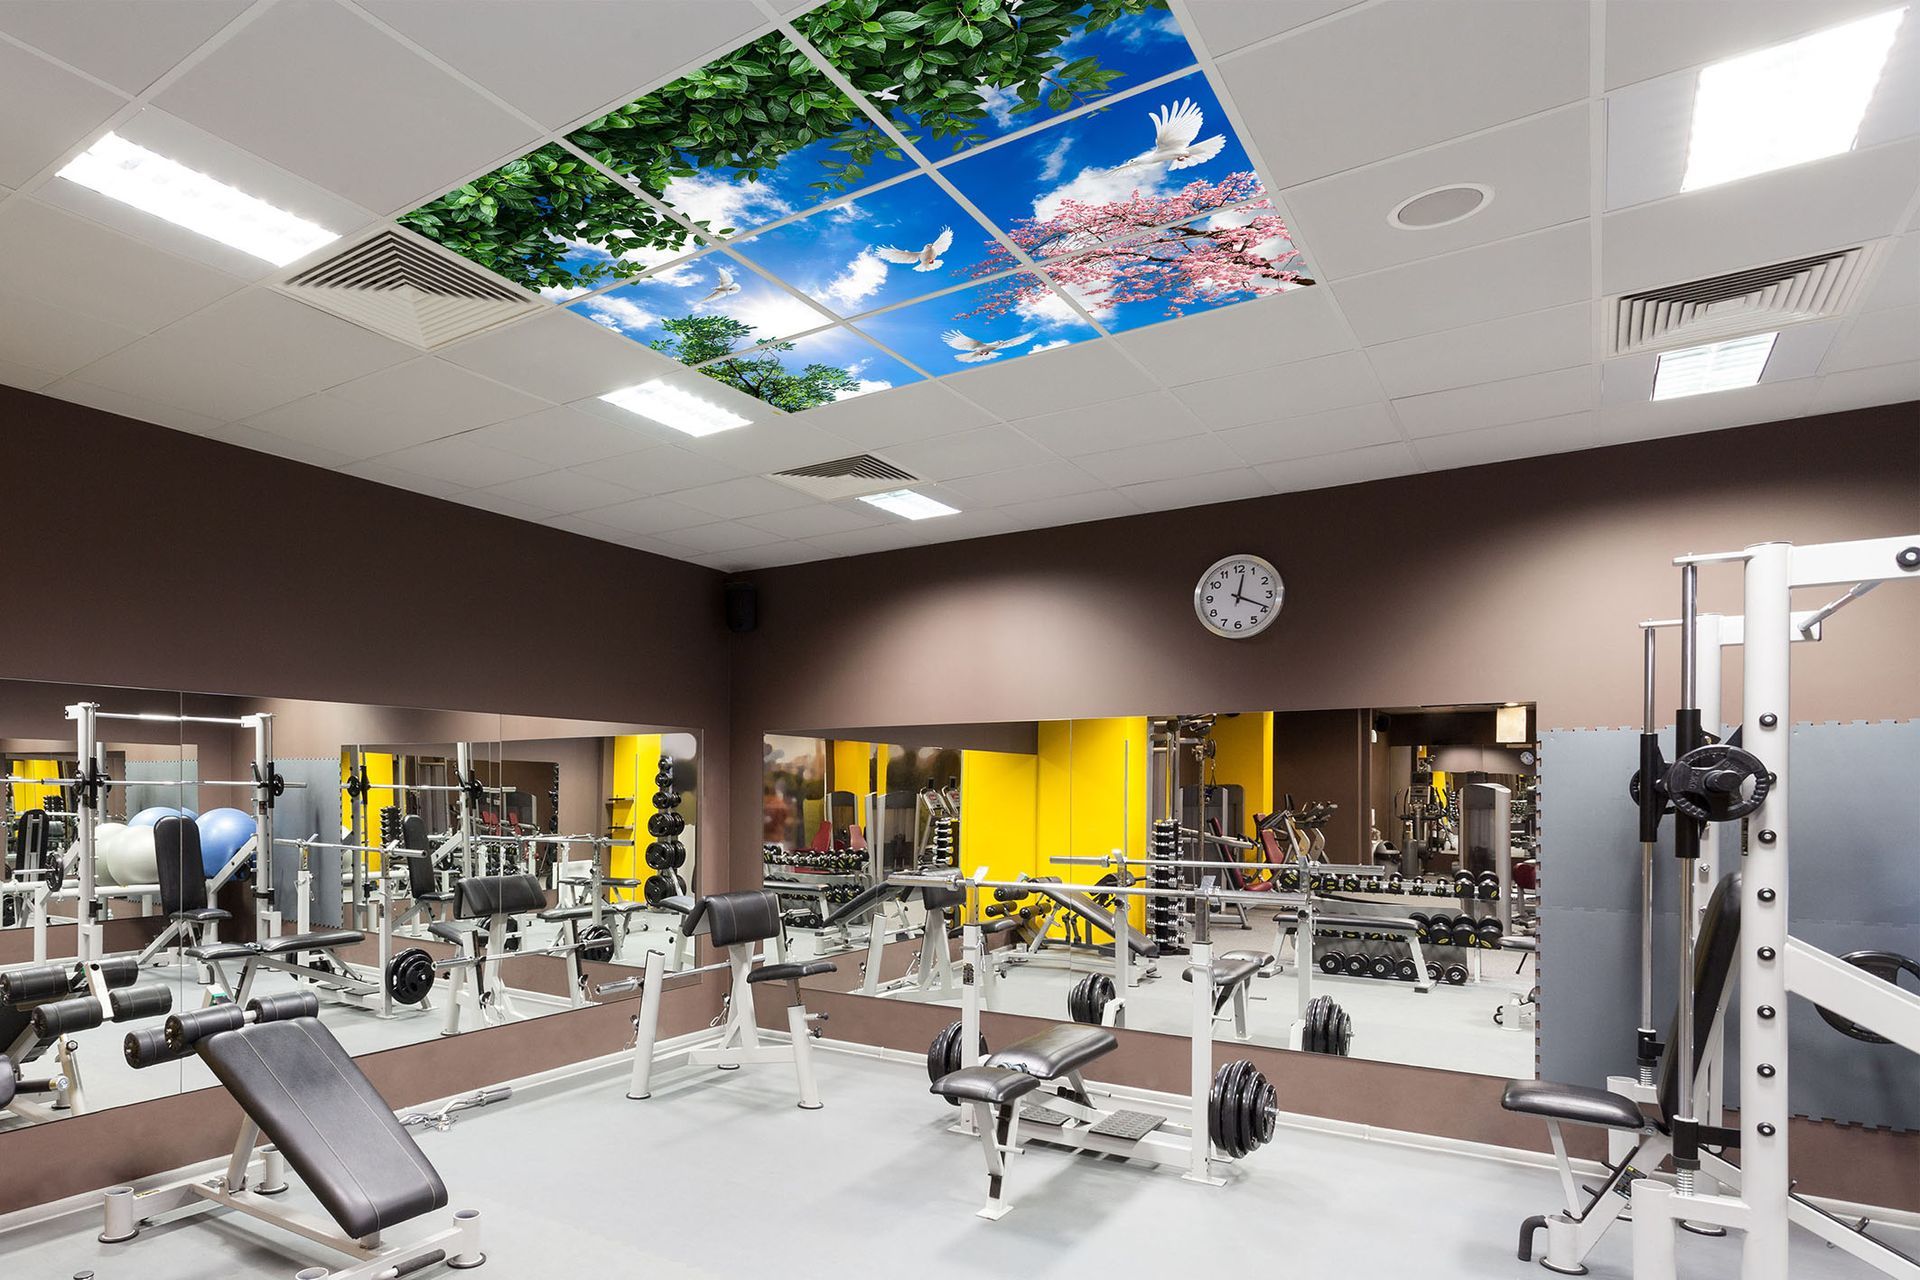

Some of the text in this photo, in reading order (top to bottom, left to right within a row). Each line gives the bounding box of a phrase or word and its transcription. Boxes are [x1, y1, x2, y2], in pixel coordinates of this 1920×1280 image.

[1234, 565, 1245, 573] 12
[1251, 567, 1256, 575] 1
[1220, 570, 1228, 579] 11
[1210, 581, 1221, 589] 10
[1261, 577, 1268, 585] 2
[1266, 590, 1273, 598] 3
[1206, 596, 1214, 604] 9
[1210, 609, 1218, 617] 8
[1221, 619, 1228, 627] 7
[1250, 616, 1258, 624] 5
[1234, 621, 1242, 629] 6
